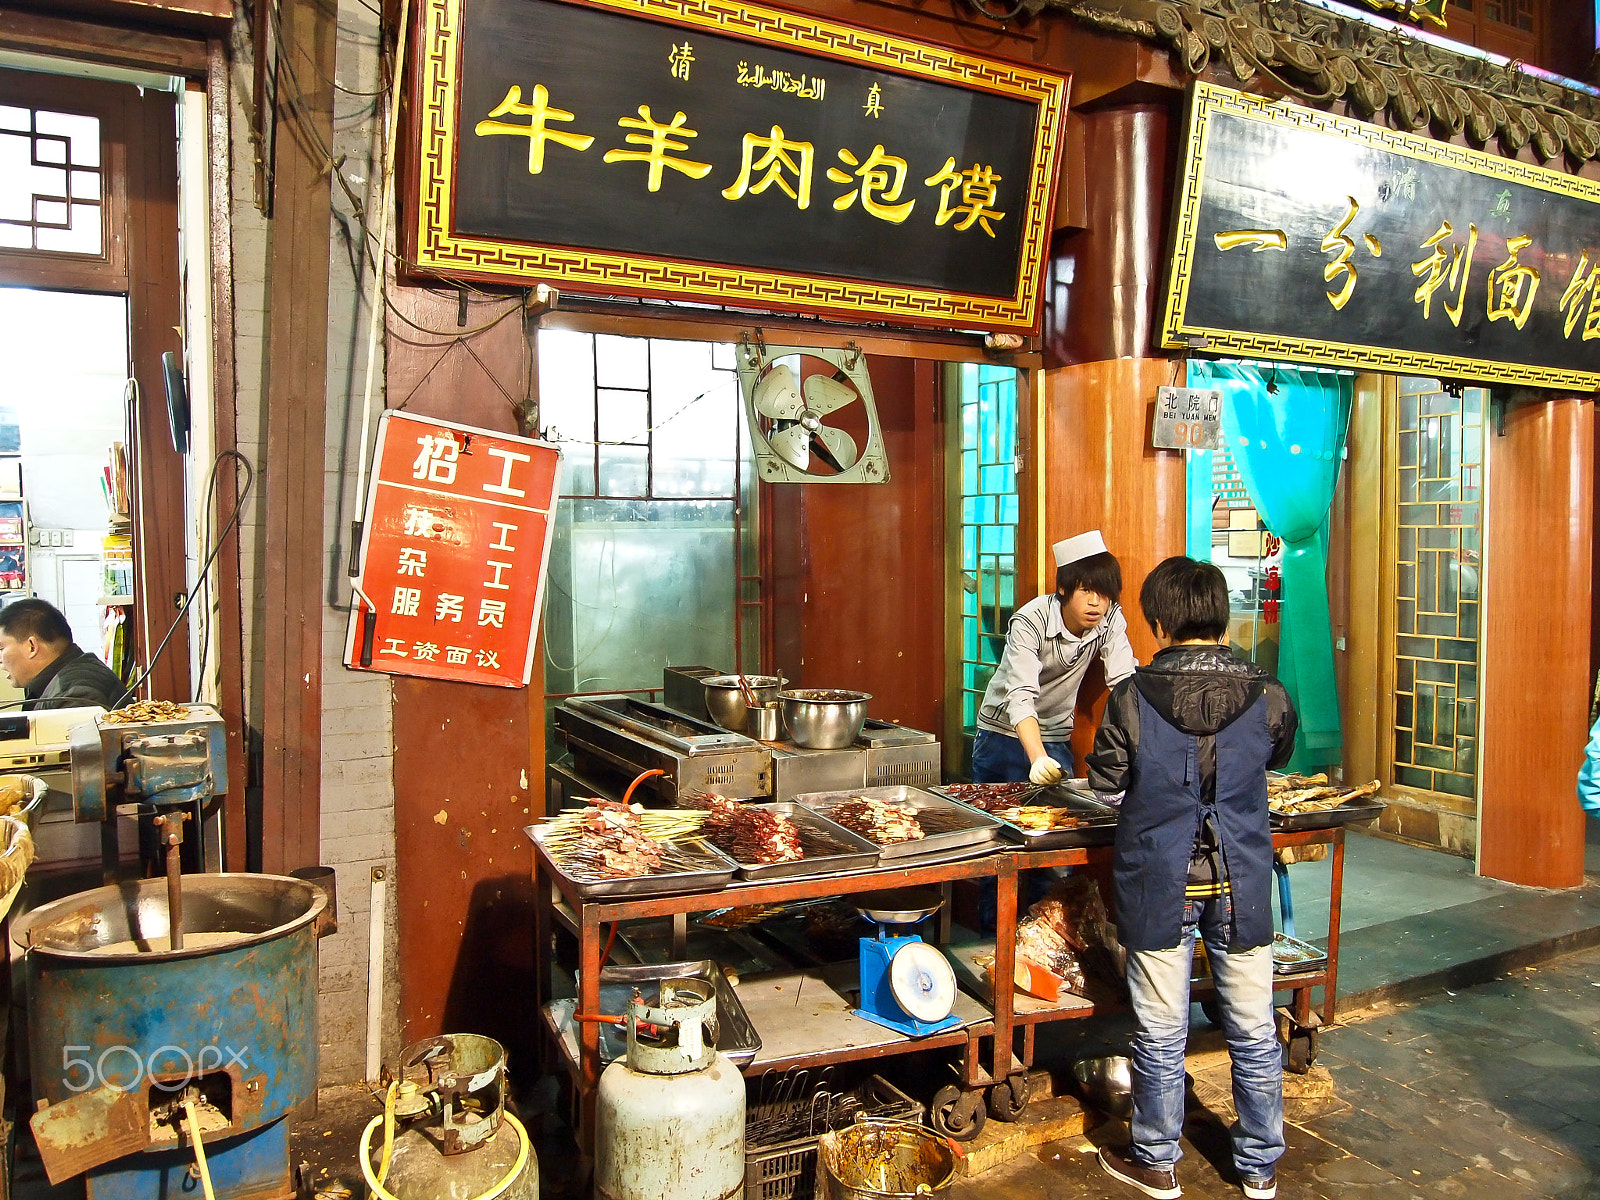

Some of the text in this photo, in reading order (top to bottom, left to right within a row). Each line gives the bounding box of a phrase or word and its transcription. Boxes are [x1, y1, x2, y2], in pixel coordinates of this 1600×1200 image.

[474, 84, 1006, 238] 牛羊肉泡馍
[1163, 411, 1177, 420] BEI
[1181, 412, 1200, 421] YUAN
[1164, 392, 1219, 413] 北院门
[1174, 422, 1203, 446] 90
[412, 434, 532, 498] 招工
[396, 547, 514, 590] 杂工
[391, 586, 507, 629] 服务员
[379, 637, 502, 670] 工资面议
